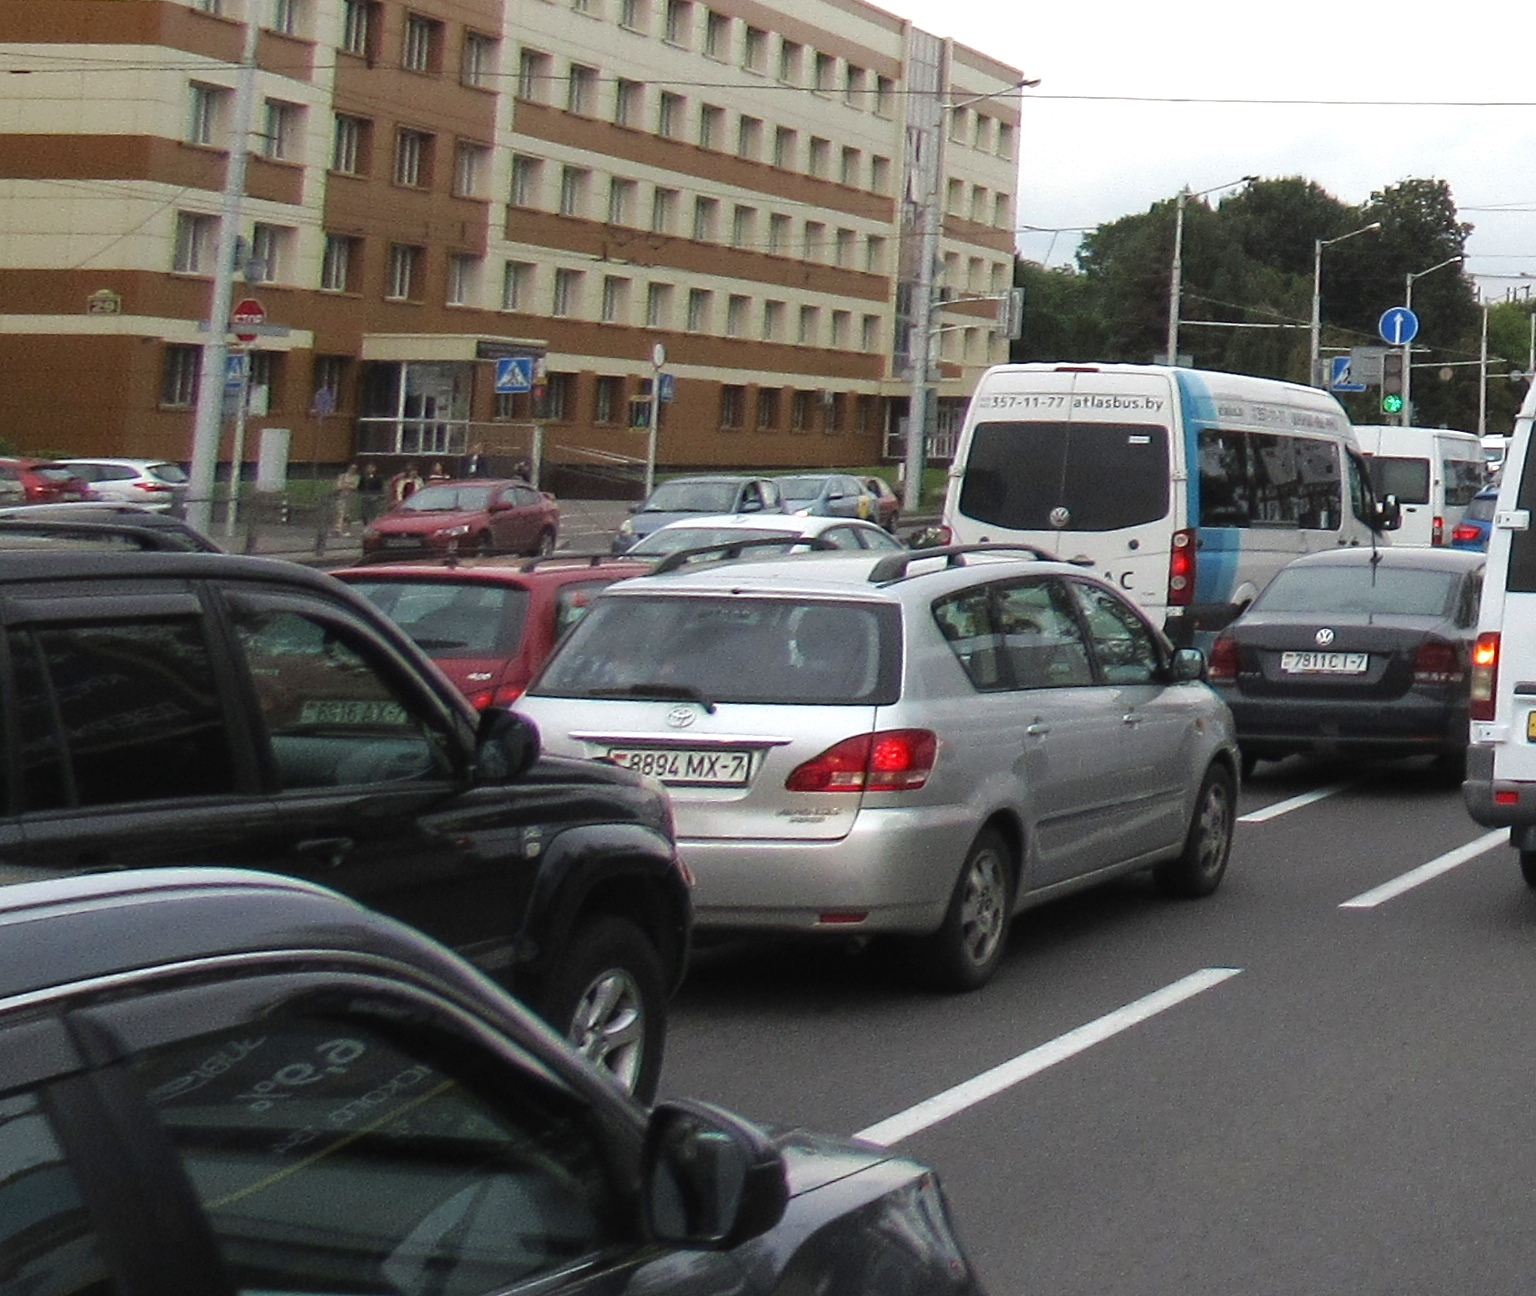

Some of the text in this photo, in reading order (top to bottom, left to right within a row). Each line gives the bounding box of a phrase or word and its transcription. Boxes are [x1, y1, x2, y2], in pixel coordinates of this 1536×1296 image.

[992, 396, 1065, 409] 357-11-77
[1073, 395, 1164, 413] atlasbus.by
[1295, 653, 1327, 668] 7911
[629, 753, 743, 778] 8894 MX-7
